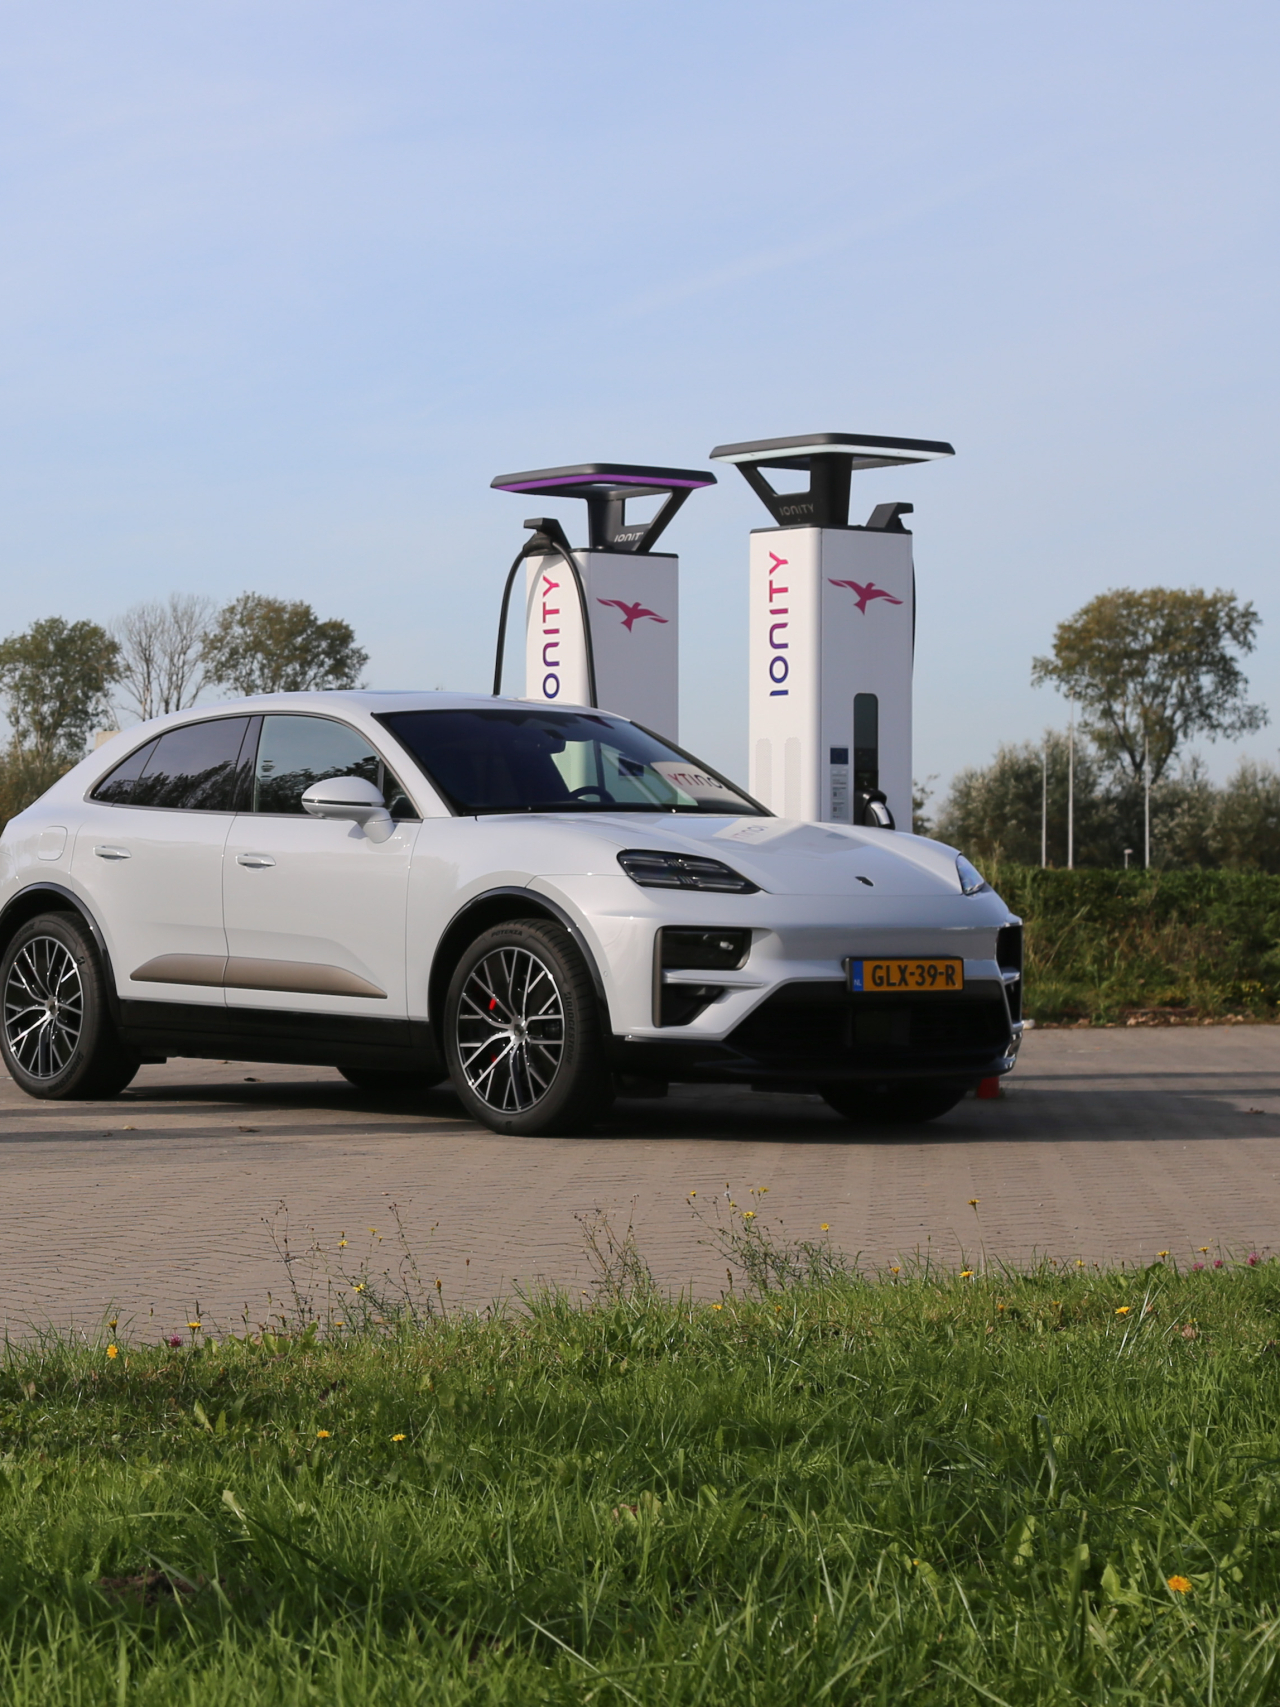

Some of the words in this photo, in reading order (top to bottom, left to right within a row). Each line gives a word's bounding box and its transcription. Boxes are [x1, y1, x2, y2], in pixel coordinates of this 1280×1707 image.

[778, 503, 814, 516] IONITY
[614, 532, 644, 543] IONIT
[768, 551, 789, 696] IONITY
[542, 575, 560, 699] ONITY
[491, 929, 523, 937] POTENZA
[872, 964, 956, 987] GLX-39-R
[564, 991, 576, 1065] BRIDGESTONE
